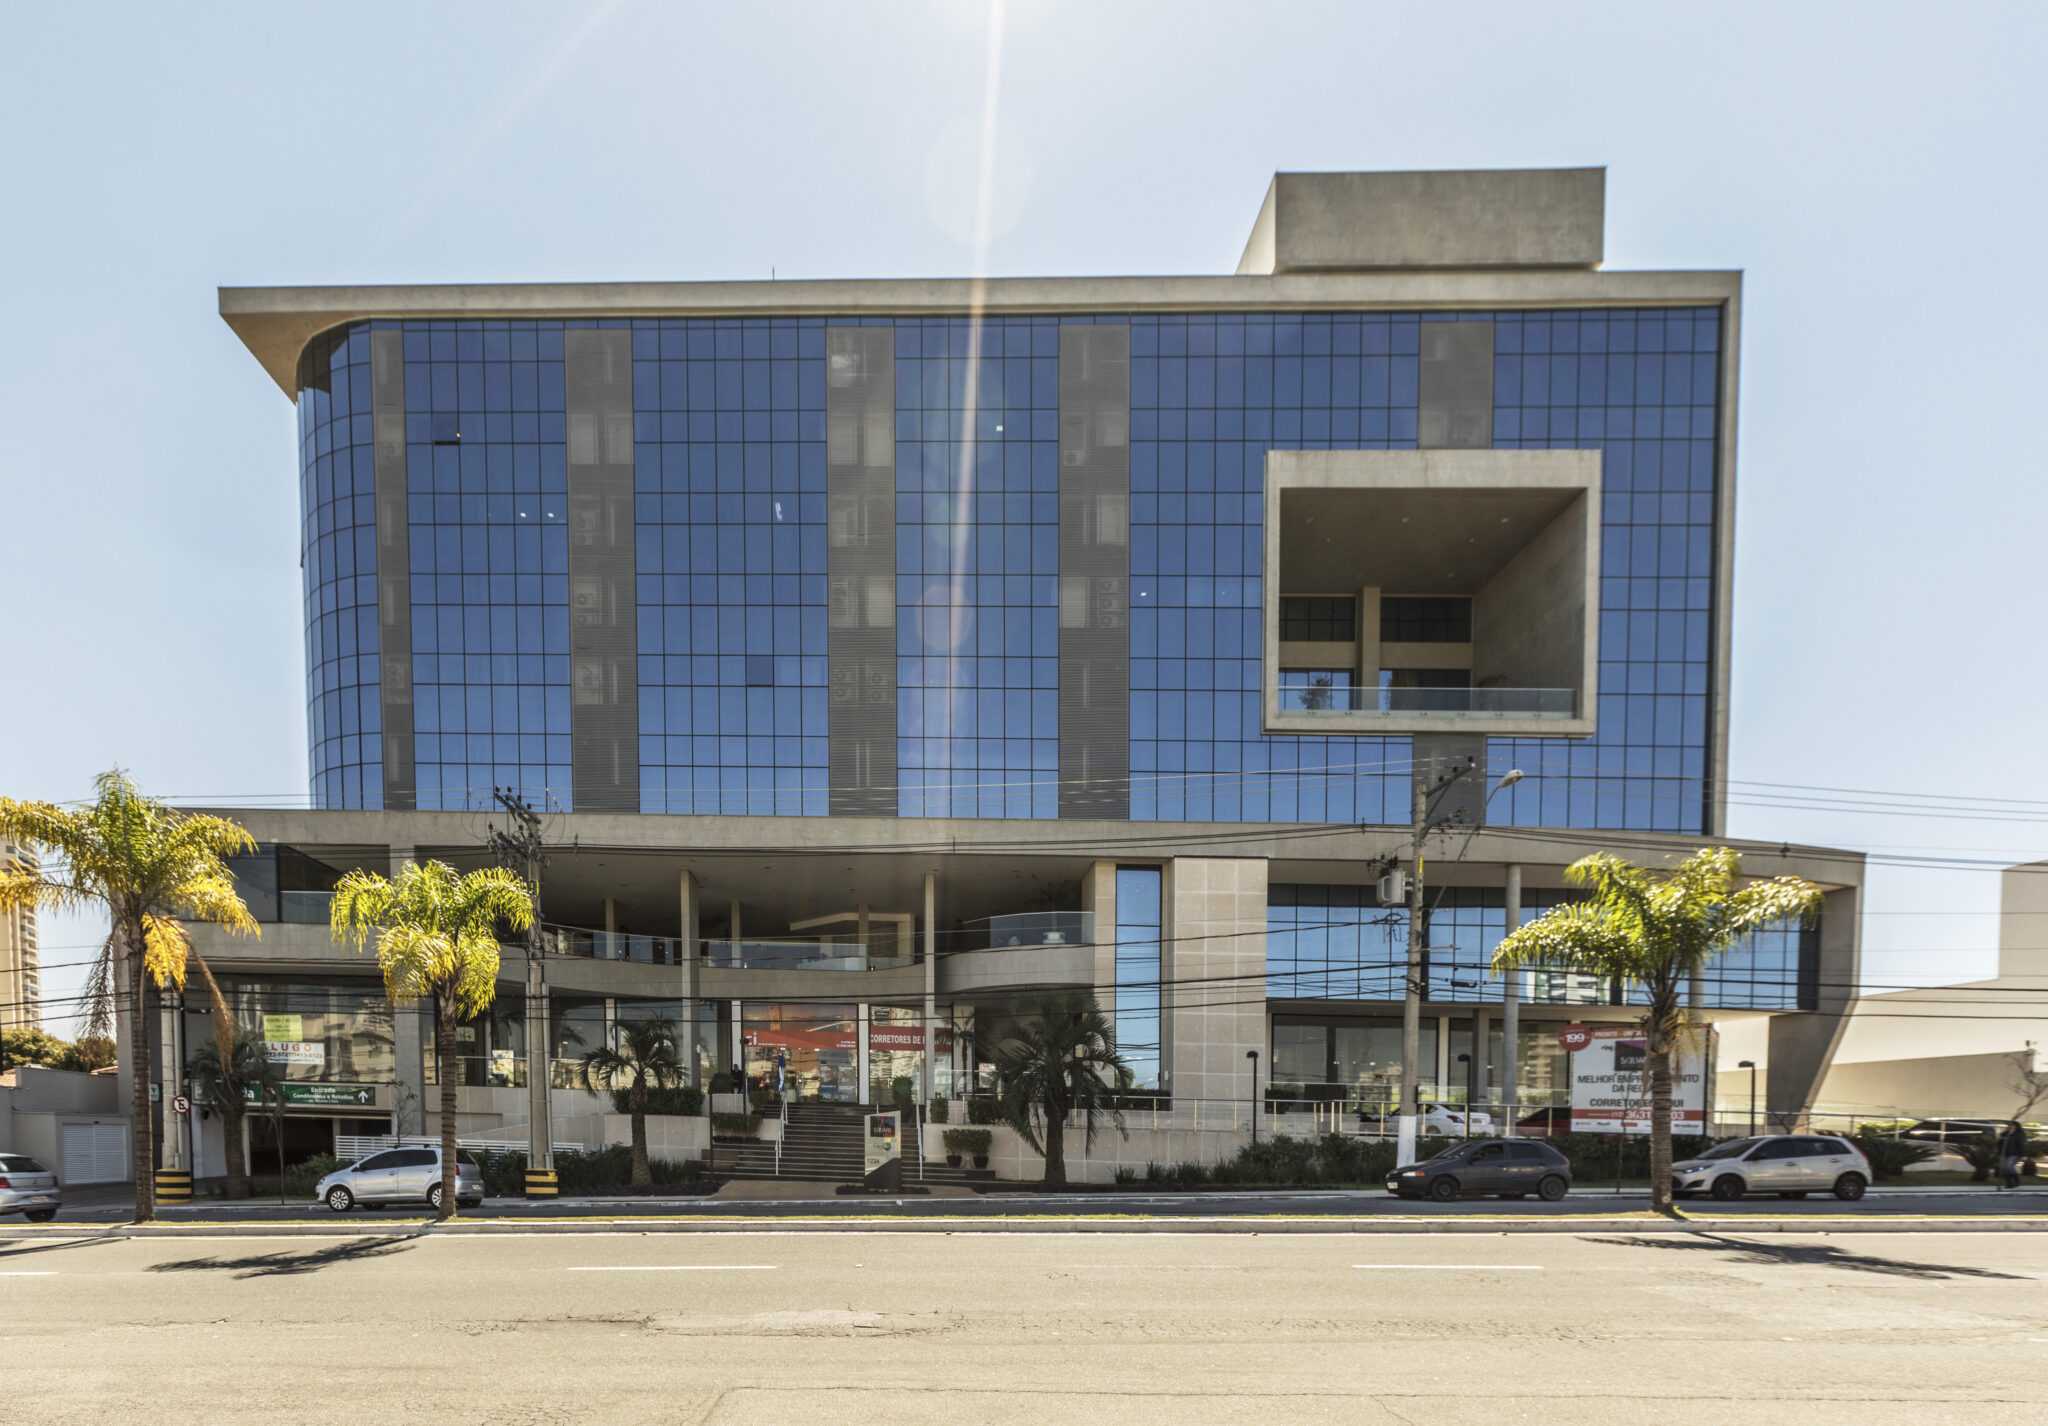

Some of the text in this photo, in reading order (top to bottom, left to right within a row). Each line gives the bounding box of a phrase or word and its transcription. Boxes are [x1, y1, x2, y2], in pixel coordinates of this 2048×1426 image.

[870, 1034, 911, 1044] CORRETORES
[913, 1036, 921, 1044] DE
[1566, 1033, 1585, 1043] 199
[1577, 1075, 1615, 1083] MELHOR
